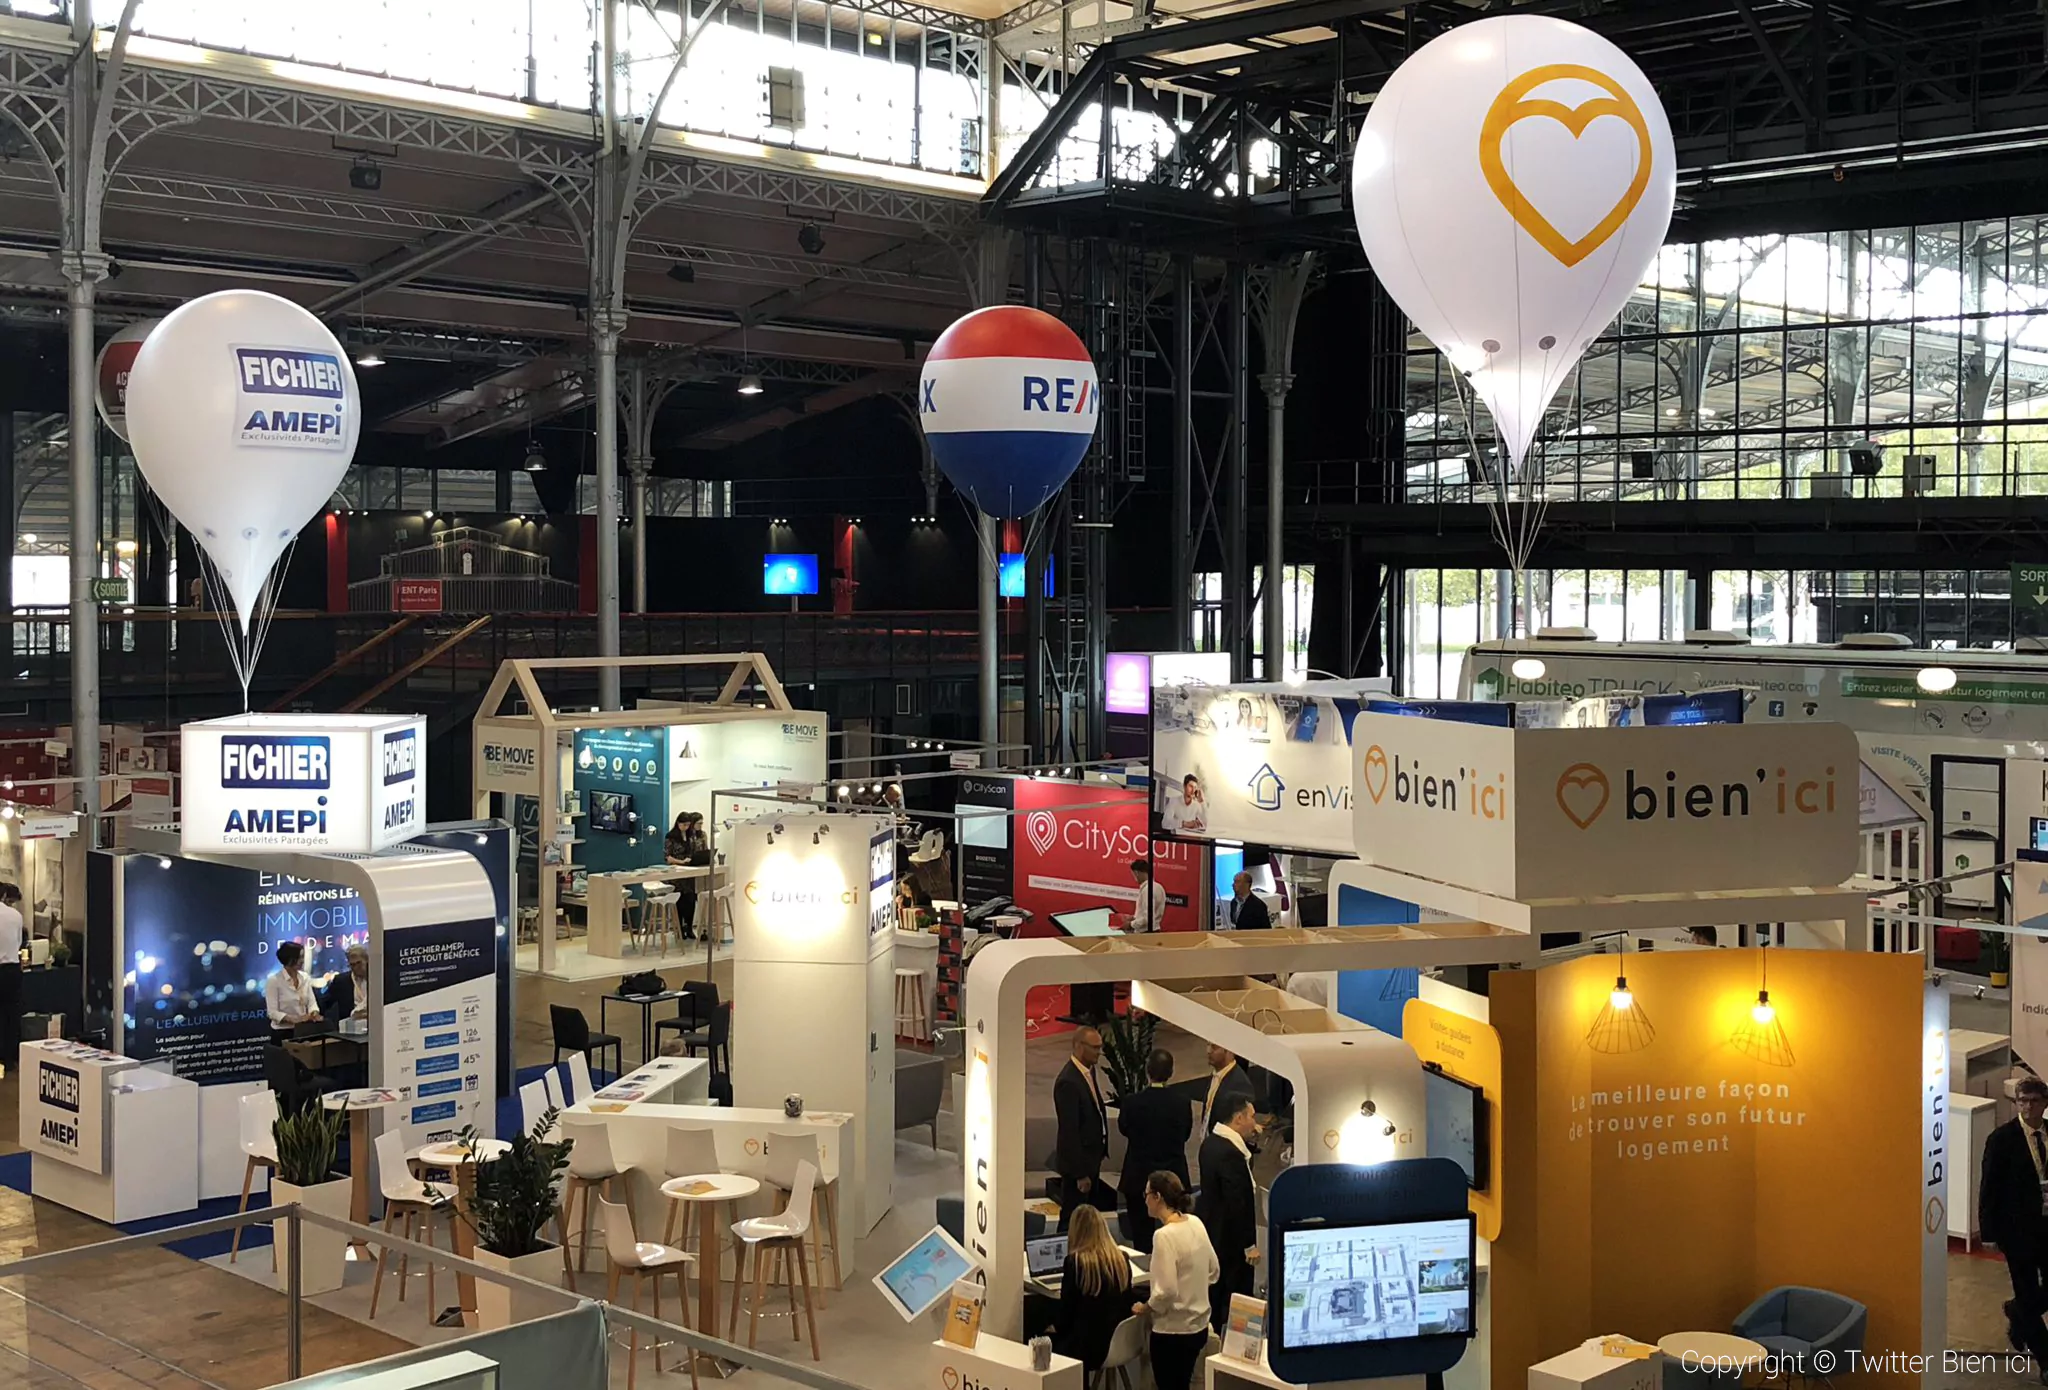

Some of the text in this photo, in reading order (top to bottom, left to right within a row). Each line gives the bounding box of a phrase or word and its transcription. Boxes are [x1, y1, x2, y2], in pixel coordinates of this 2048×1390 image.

[241, 356, 341, 392] FICHIER
[100, 582, 128, 597] SORTIE
[1507, 677, 1585, 697] Habiteo
[1847, 682, 1880, 693] Entrez
[1883, 684, 1913, 694] visiter
[1975, 687, 2028, 699] logement
[2032, 691, 2045, 699] en
[796, 725, 818, 737] MOVE
[384, 738, 415, 777] FICHIER
[503, 747, 534, 765] MOVE
[1871, 747, 1902, 758] VISITE
[223, 744, 328, 781] FICHIER
[1395, 754, 1505, 820] bien'ici
[1626, 766, 1836, 820] bien'ici
[1297, 785, 1353, 810] enVi
[223, 834, 328, 846] Exclusivités Partagées
[258, 887, 353, 905] RÉINVENTONS LE
[258, 905, 367, 933] IMMOBIL
[400, 941, 465, 957] LE FICHIER AMEPI
[400, 948, 480, 966] C'EST TOUT BÉNÉFICE
[156, 1010, 239, 1029] L'EXCLUSIVITÉ
[165, 1035, 189, 1043] solution
[190, 1034, 204, 1042] pour
[465, 1028, 478, 1036] 126
[195, 1042, 211, 1050] votre
[40, 1068, 79, 1106] FICHIER
[1571, 1080, 1789, 1112] La meilleure façon
[1569, 1105, 1806, 1141] de trouver son futur
[1618, 1135, 1729, 1160] logement
